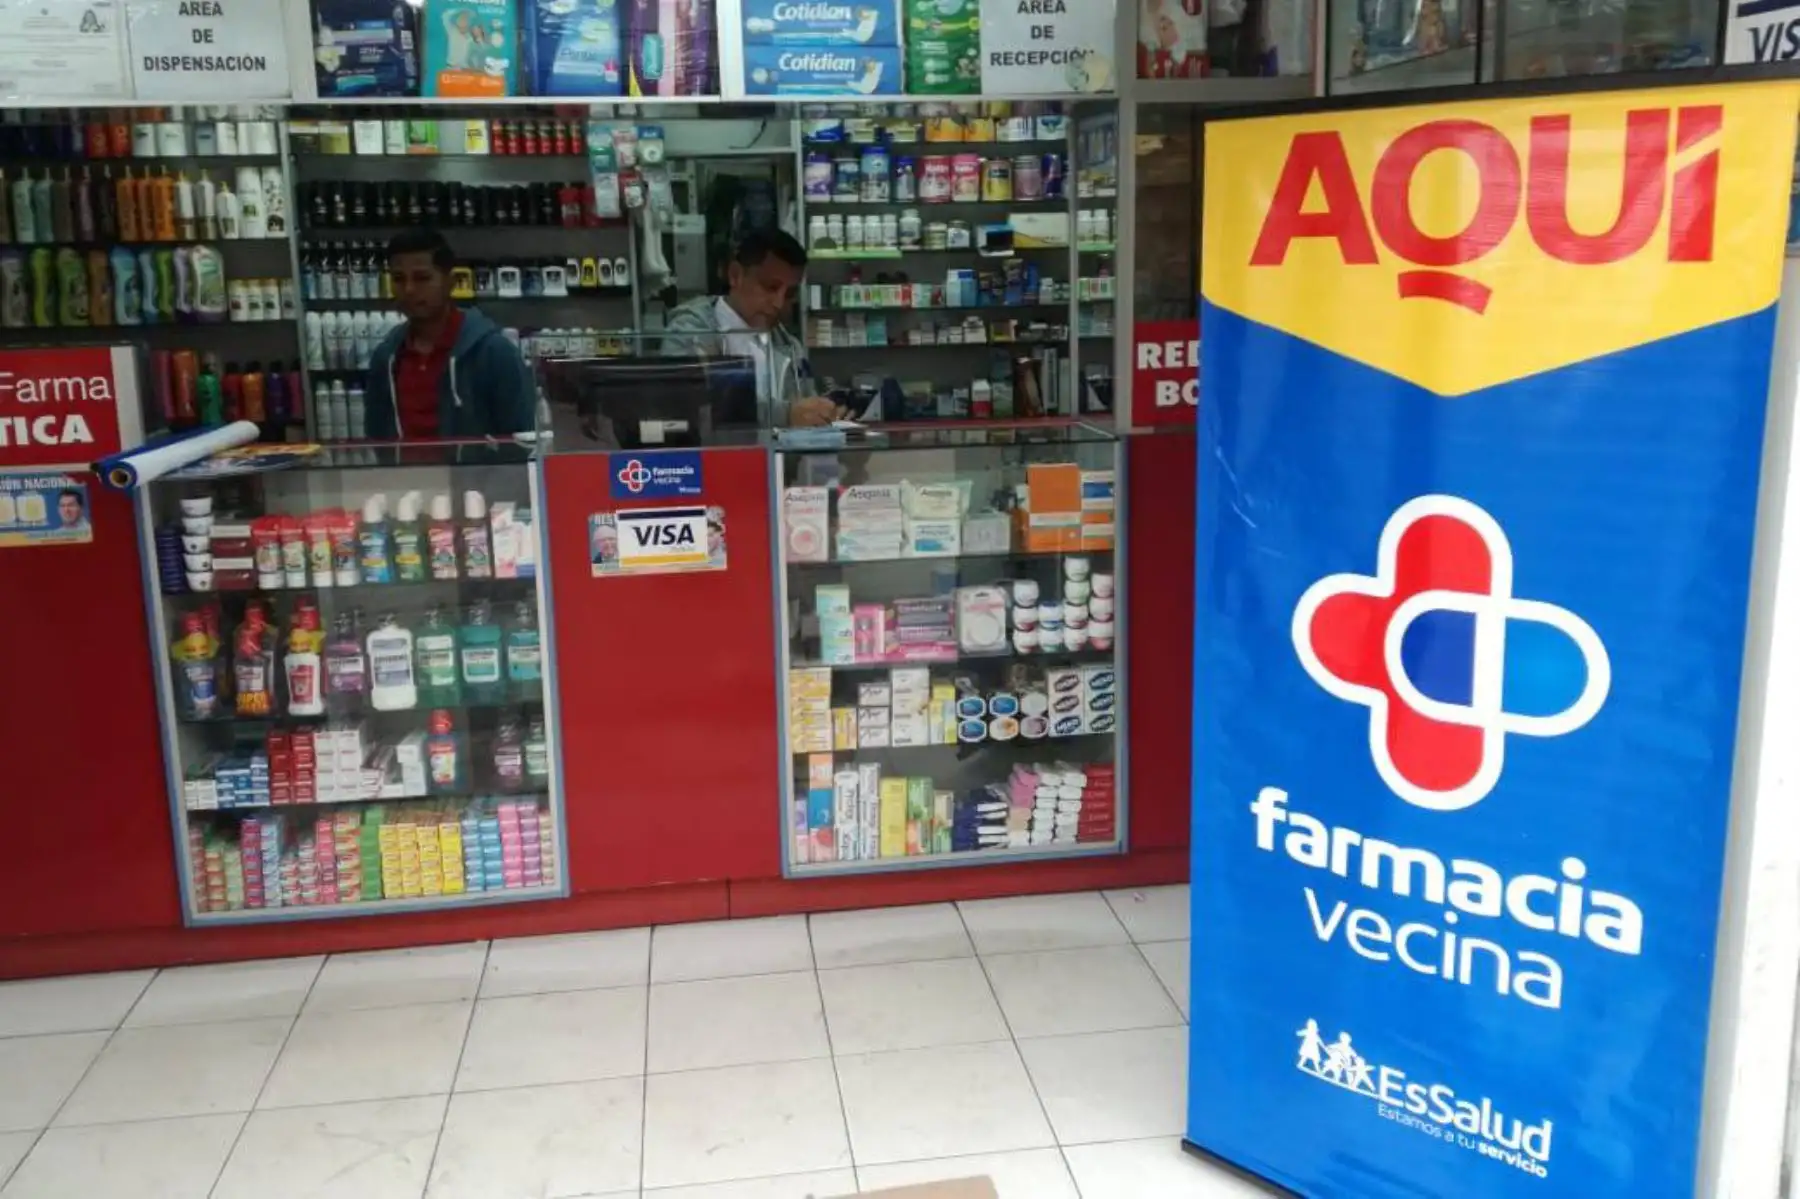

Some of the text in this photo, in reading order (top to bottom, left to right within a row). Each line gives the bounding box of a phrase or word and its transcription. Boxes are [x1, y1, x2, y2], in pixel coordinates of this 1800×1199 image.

[773, 2, 852, 21] Cotidian
[192, 29, 214, 43] DE
[1031, 25, 1055, 39] DE
[778, 53, 856, 72] Cotidian
[632, 524, 695, 546] VISA
[1249, 786, 1643, 956] farmacia
[1303, 886, 1564, 1009] vecina
[1379, 1064, 1553, 1161] EsSalud
[1377, 1103, 1548, 1178] Estamos a tu servicio
